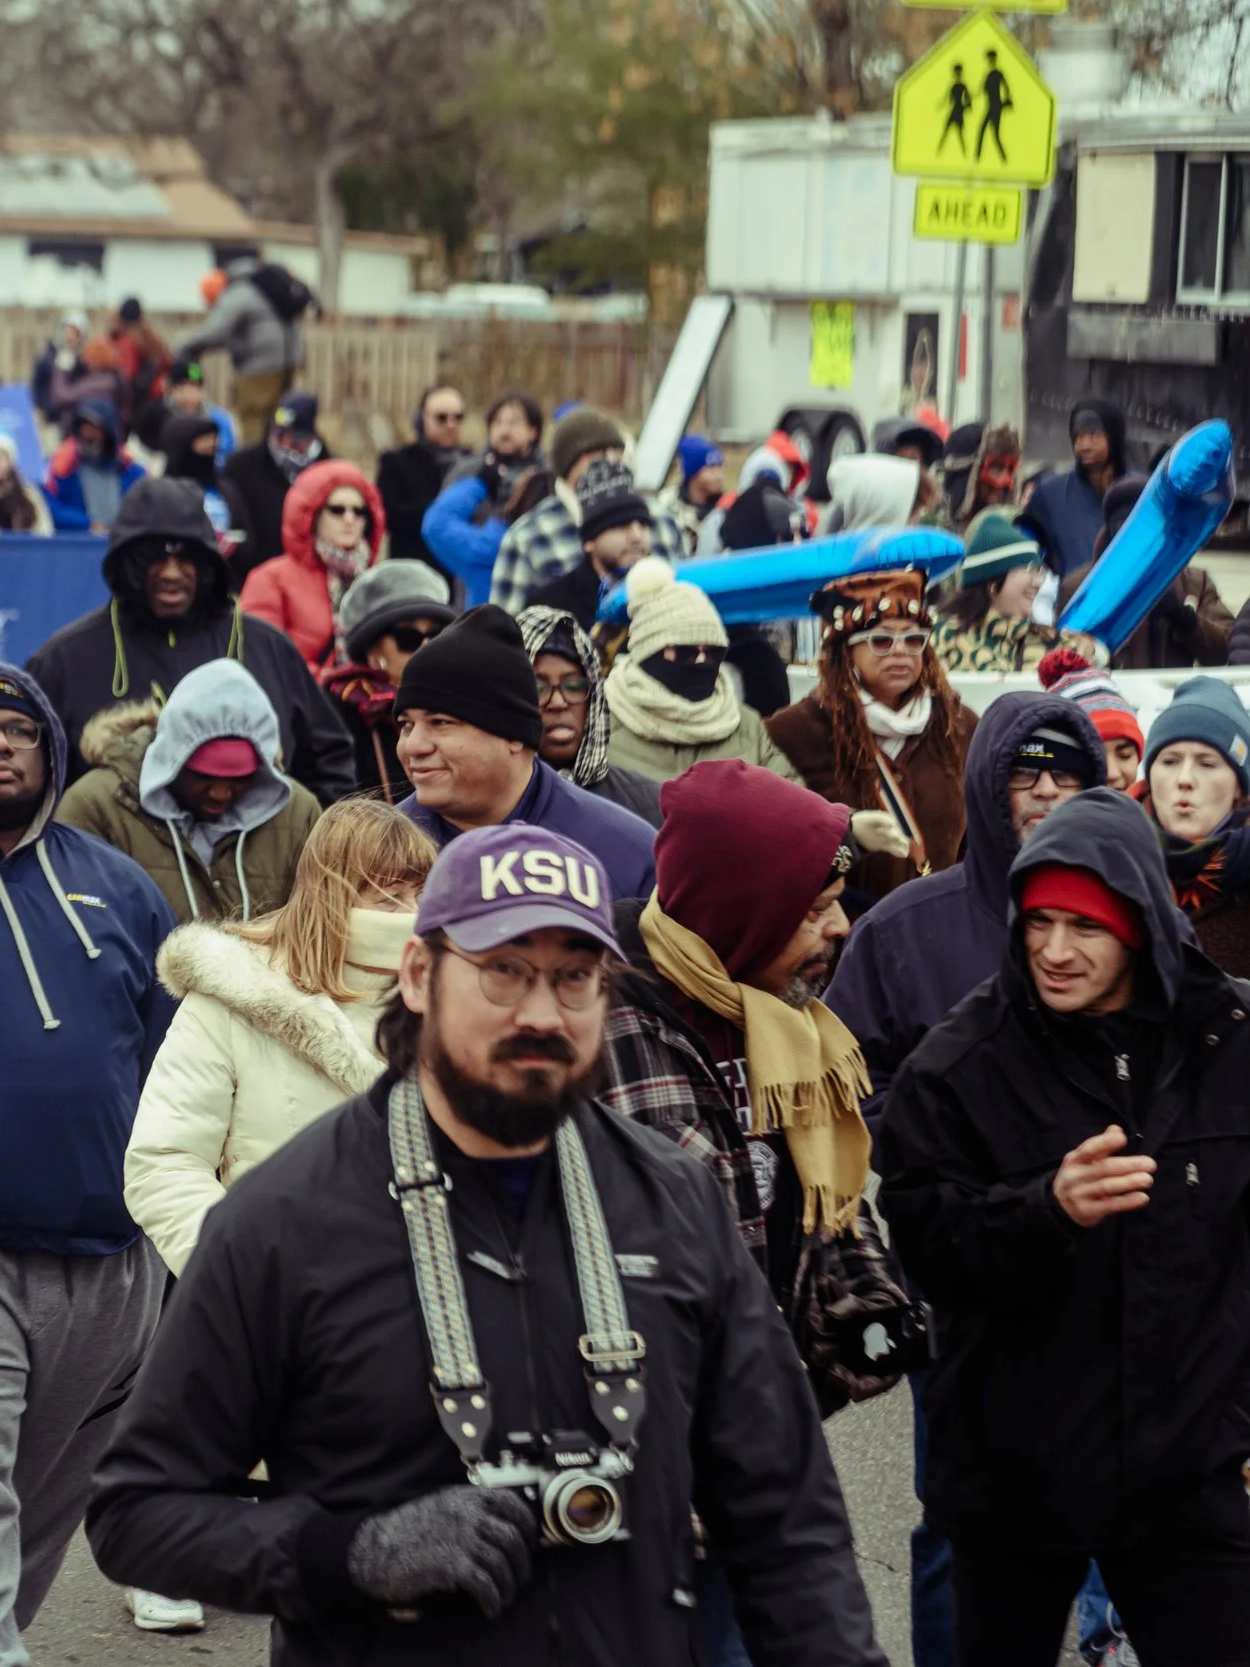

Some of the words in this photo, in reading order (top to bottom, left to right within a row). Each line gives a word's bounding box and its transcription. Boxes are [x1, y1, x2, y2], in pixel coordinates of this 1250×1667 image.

[927, 196, 1008, 228] AHEAD
[479, 850, 600, 909] KSU
[555, 1452, 592, 1466] Nikon
